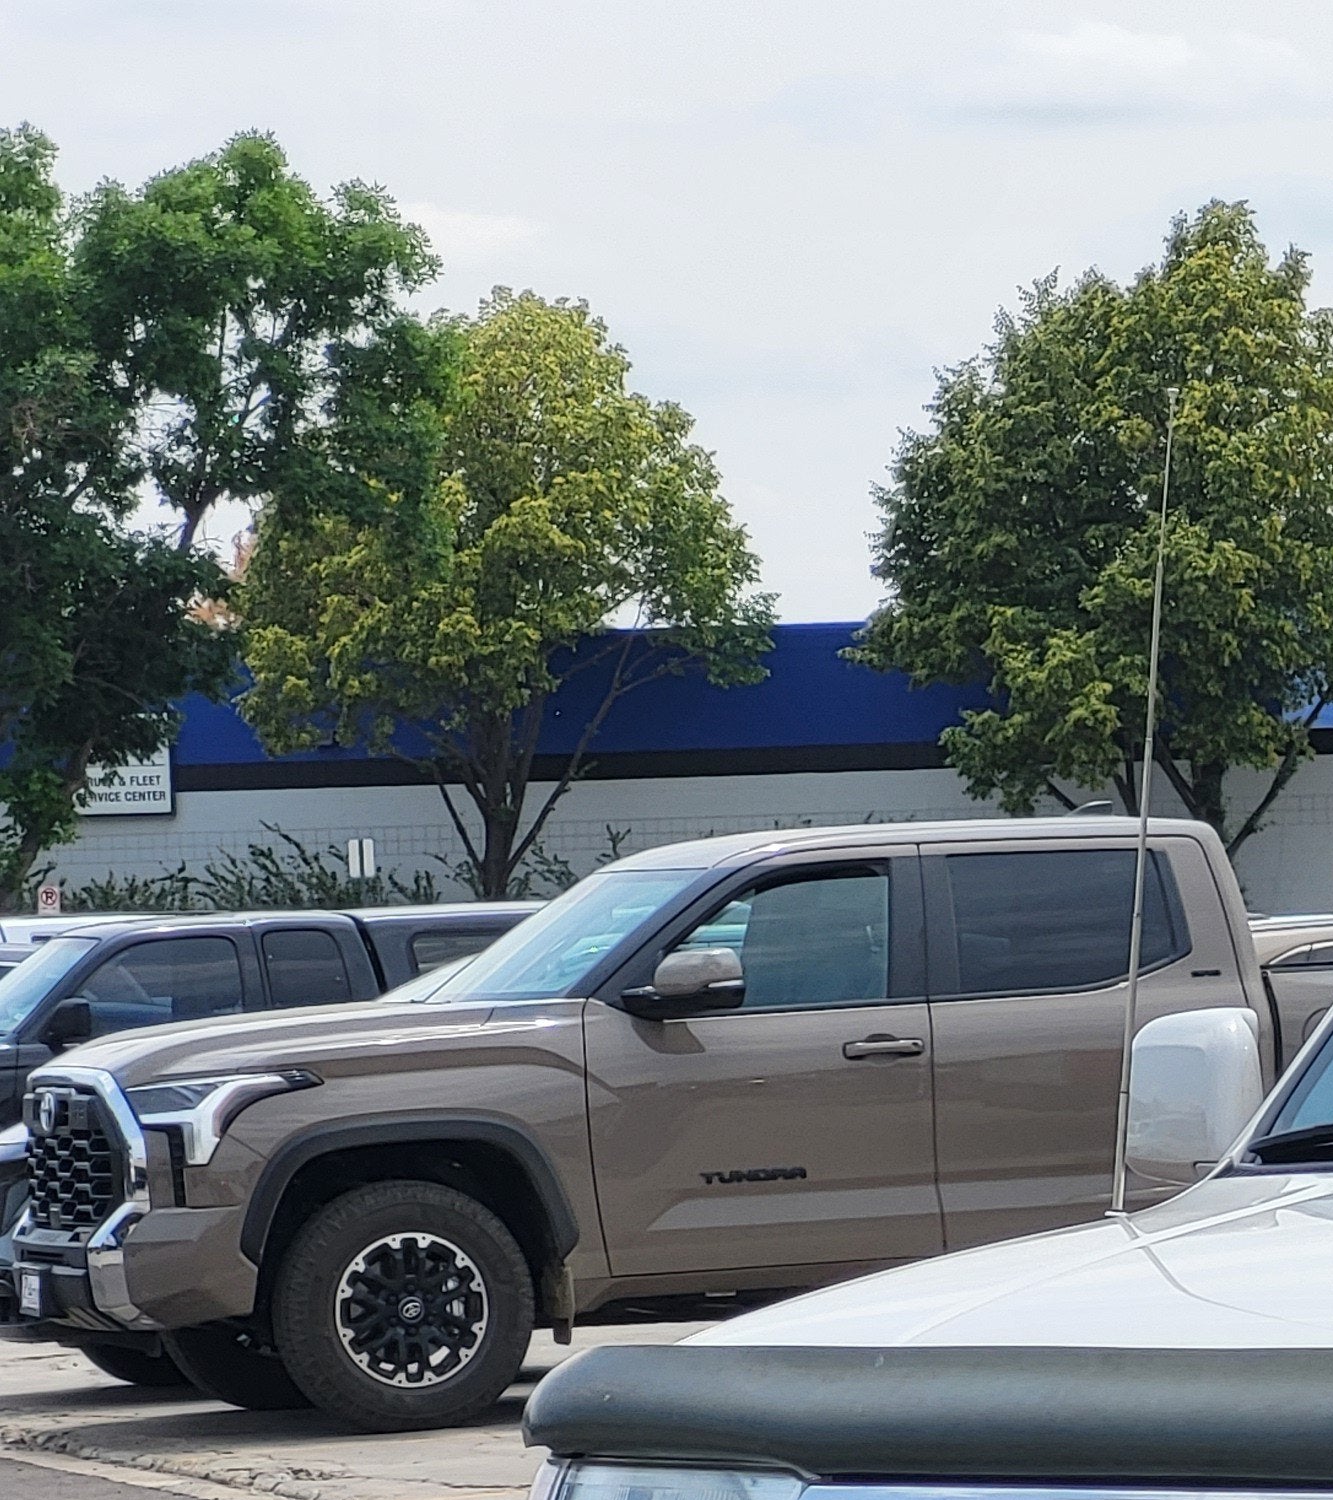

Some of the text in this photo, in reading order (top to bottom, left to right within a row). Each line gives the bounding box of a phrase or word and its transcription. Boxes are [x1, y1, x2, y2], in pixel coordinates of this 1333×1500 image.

[130, 775, 161, 786] FLEET
[124, 790, 166, 802] CENTER
[699, 1167, 807, 1185] TUNDRA
